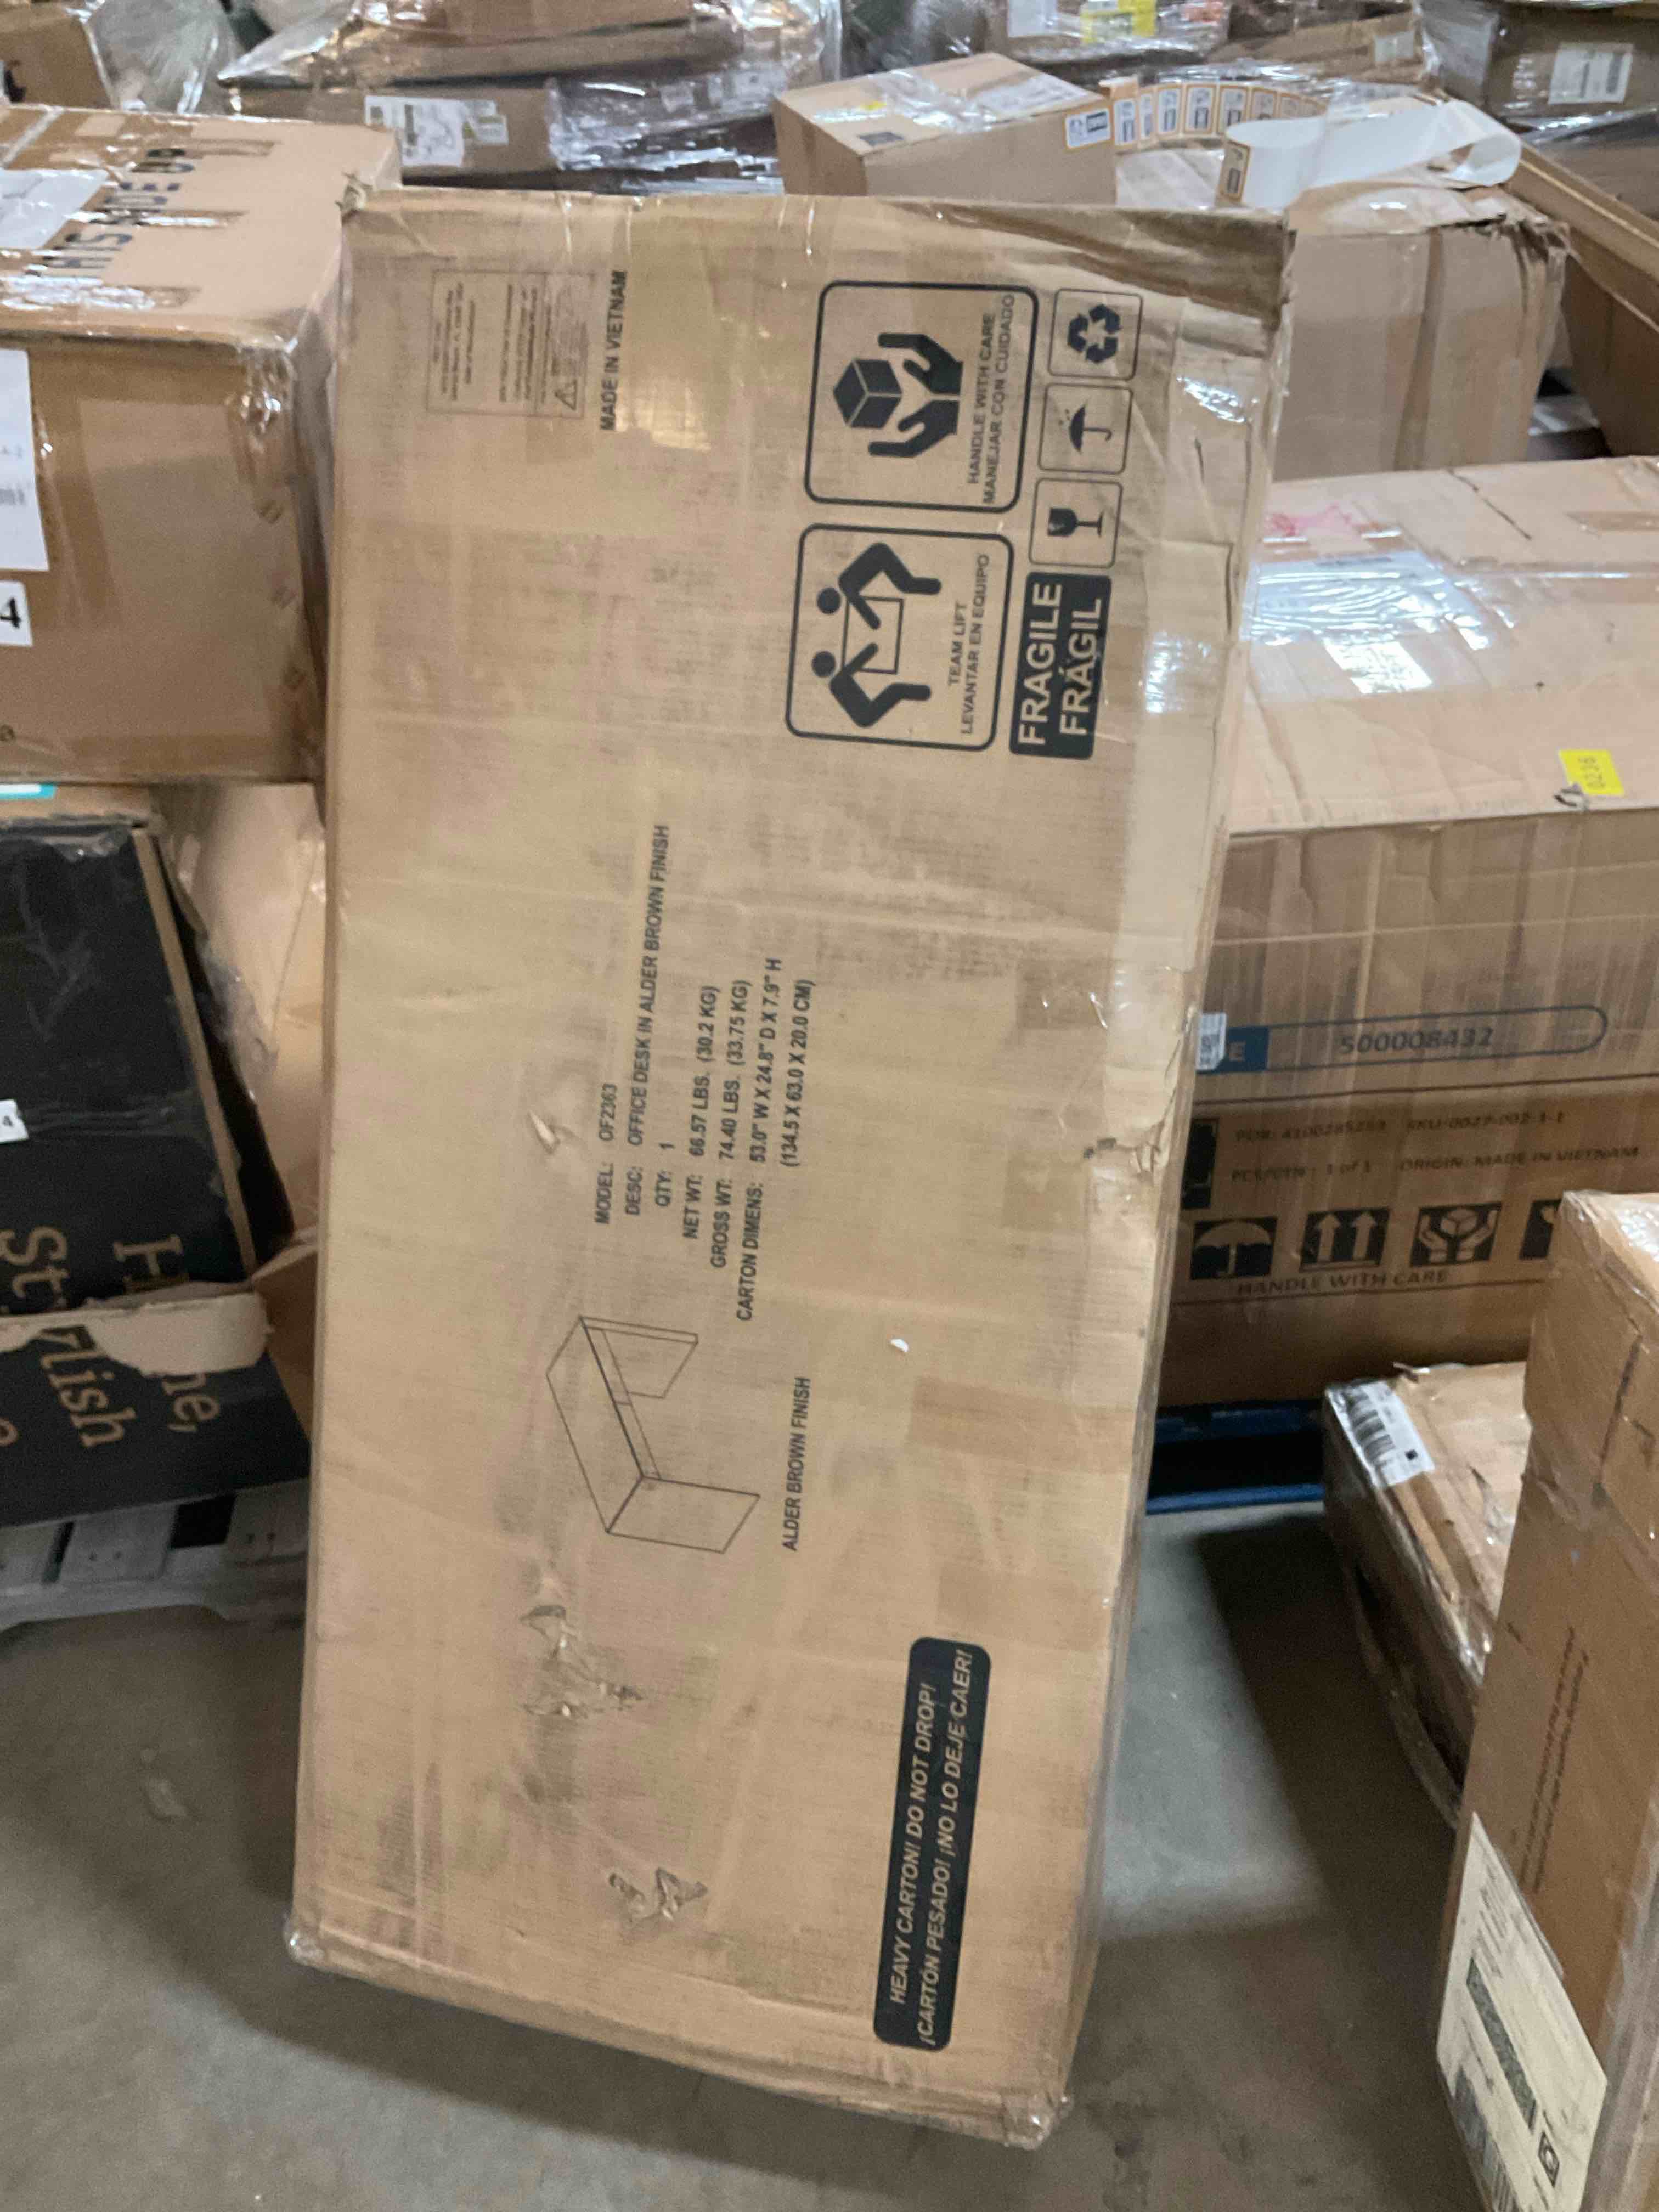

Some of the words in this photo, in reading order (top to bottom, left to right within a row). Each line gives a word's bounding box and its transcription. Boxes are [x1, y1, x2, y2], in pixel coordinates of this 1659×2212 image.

[606, 270, 627, 349] VIETNAM
[979, 312, 995, 360] CARE
[995, 295, 1014, 373] CUIDADO
[604, 357, 618, 373] IN
[974, 366, 991, 409] WITH
[600, 380, 618, 430] MADE
[991, 378, 1006, 415] CON
[967, 414, 985, 483] HANDLE
[983, 421, 1002, 503] MANEJAR
[972, 554, 990, 618] EQUIPO
[952, 600, 967, 635] LIFT
[969, 623, 983, 645] EN
[947, 640, 964, 686] TEAM
[1018, 583, 1062, 745] FRAGILE
[1058, 598, 1101, 735] FRÁGIL
[961, 650, 980, 735] LEVANTAR
[650, 825, 669, 882] FINISH
[645, 887, 664, 951] BROWN
[639, 956, 657, 1012] ALDER
[765, 958, 782, 970] H
[700, 986, 720, 1018] KG)
[731, 980, 751, 1012] KG)
[761, 1012, 777, 1023] X
[793, 980, 816, 1012] CM)
[637, 1018, 652, 1032] IN
[696, 1023, 714, 1062] (30.2
[726, 1017, 746, 1065] (33.75
[760, 1028, 776, 1040] D
[791, 1017, 808, 1048] 20.0
[633, 1038, 650, 1083] DESK
[789, 1054, 805, 1064] X
[692, 1074, 710, 1109] LBS.
[723, 1077, 740, 1113] LBS.
[755, 1088, 769, 1098] X
[786, 1069, 803, 1101] 63.0
[599, 1084, 617, 1141] OF2363
[628, 1086, 647, 1146] OFFICE
[754, 1102, 769, 1118] W
[785, 1107, 800, 1116] X
[719, 1119, 738, 1160] 74.40
[780, 1121, 800, 1166] (134.5
[1475, 1152, 1526, 1166] MADE
[1532, 1151, 1552, 1163] IN
[1555, 1146, 1639, 1161] VIETNAM
[595, 1163, 613, 1224] MODEL:
[625, 1167, 642, 1215] DESC:
[655, 1171, 672, 1207] QTY:
[686, 1175, 702, 1203] WT:
[715, 1179, 732, 1206] WT:
[683, 1208, 700, 1239] NET
[742, 1183, 763, 1250] DIMENS:
[710, 1212, 730, 1268] GROSS
[737, 1255, 757, 1321] CARTON
[1237, 1274, 1323, 1295] HANDLE
[1331, 1271, 1387, 1289] WITH
[1393, 1269, 1449, 1286] CARE
[791, 1377, 811, 1429] FINISH
[786, 1433, 806, 1493] BROWN
[782, 1497, 801, 1551] ALDER
[950, 1650, 973, 1719] CAER!
[913, 1683, 936, 1753] DROP!
[944, 1724, 967, 1778] DEJE
[908, 1758, 930, 1801] NOT
[940, 1782, 960, 1812] LO
[906, 1804, 924, 1838] DO
[936, 1816, 957, 1856] ¡NO
[895, 1843, 921, 1933] CARTON!
[925, 1860, 950, 1951] PESADO!
[890, 1935, 911, 2005] HEAVY
[916, 1955, 941, 2044] ¡CARTÓN
